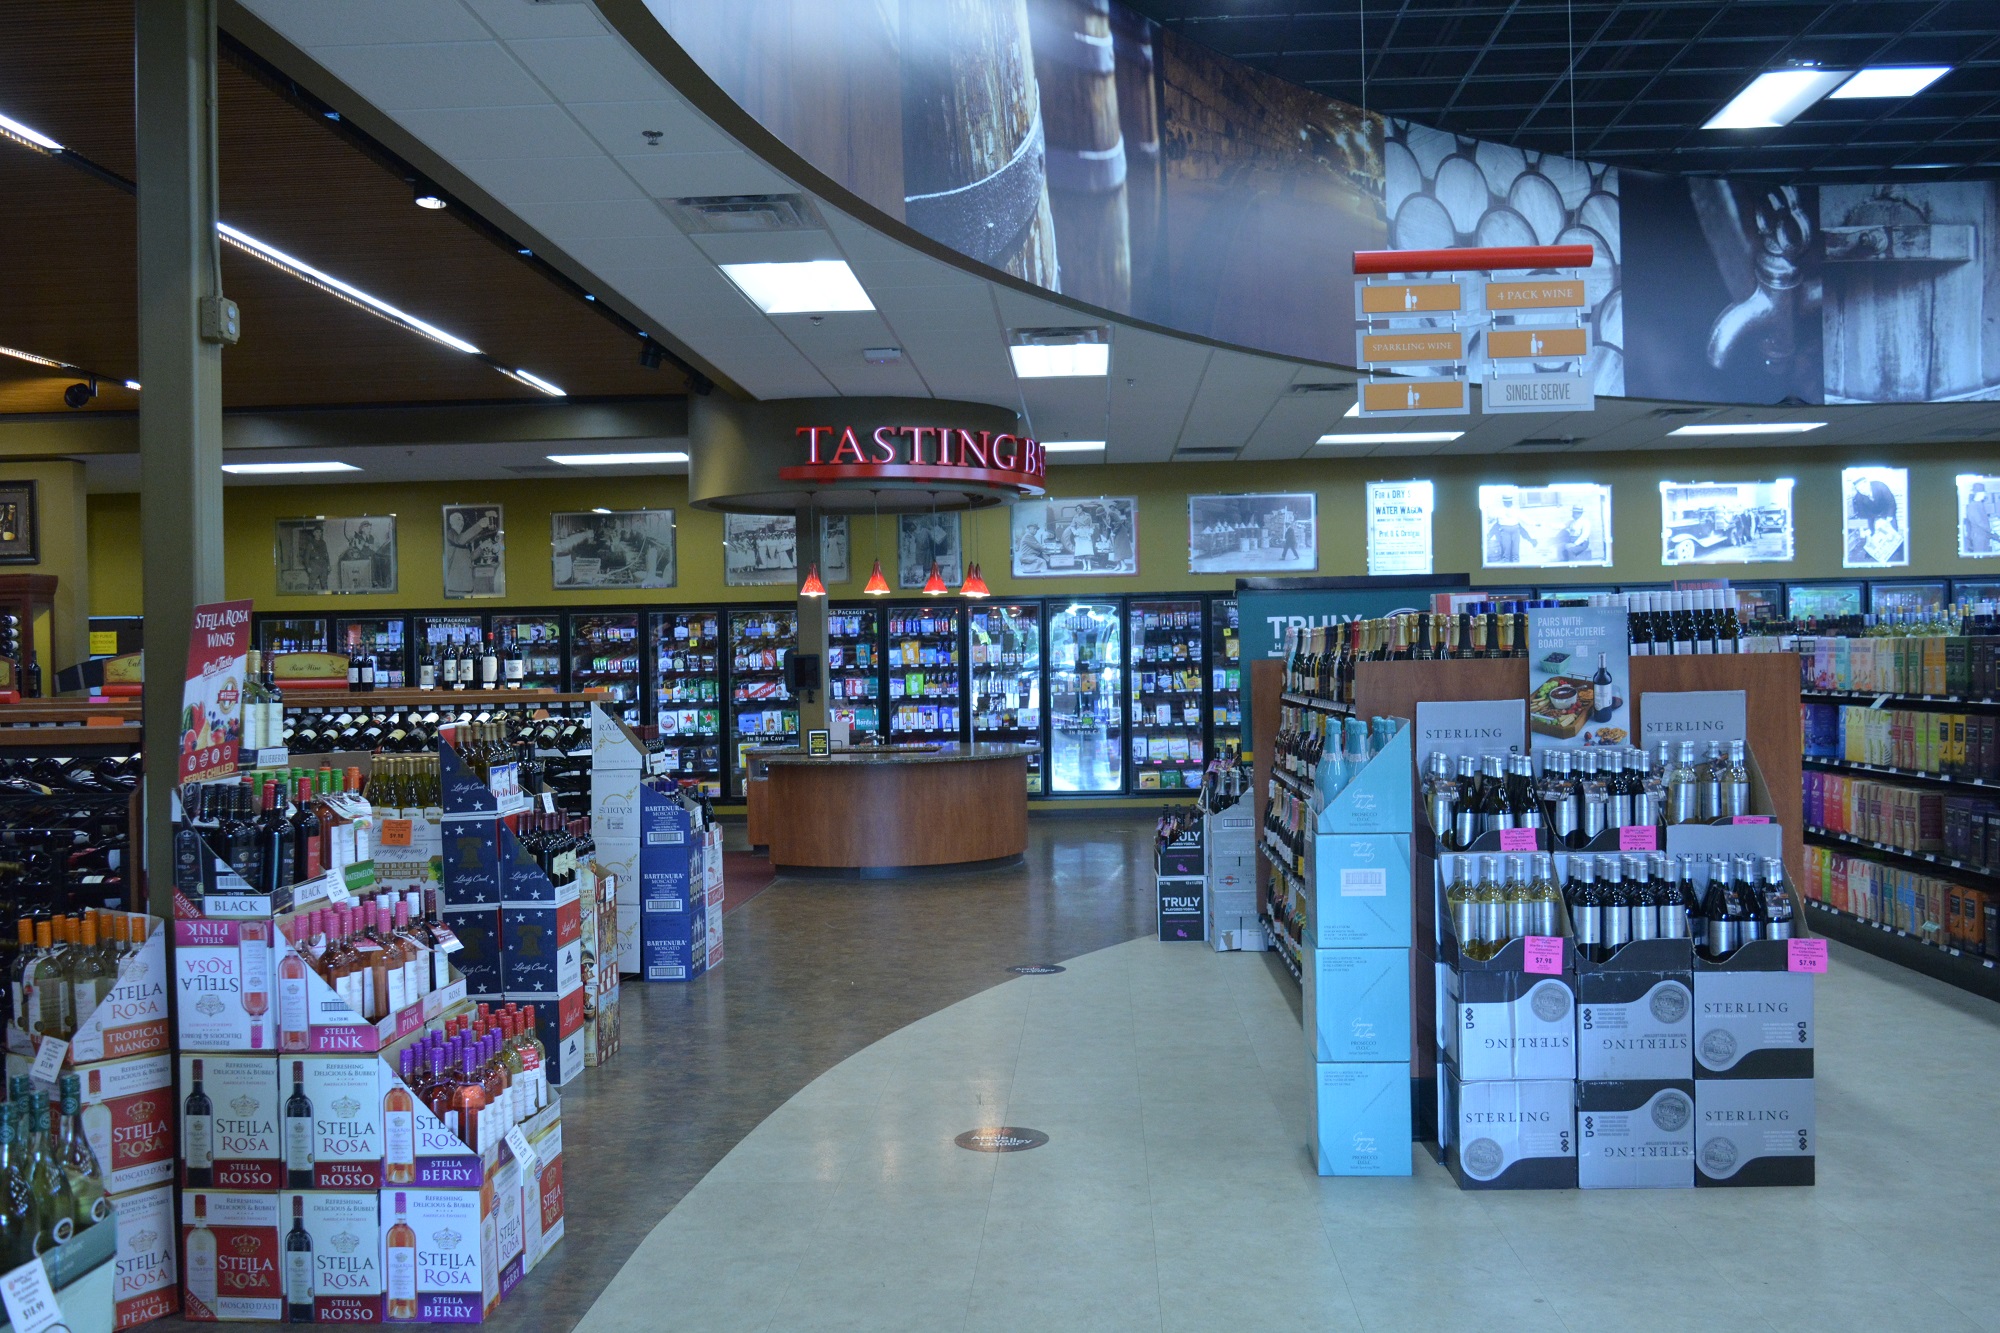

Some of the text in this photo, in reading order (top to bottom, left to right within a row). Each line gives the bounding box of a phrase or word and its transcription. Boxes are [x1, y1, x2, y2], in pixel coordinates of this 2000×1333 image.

[1497, 288, 1573, 301] 4 PACK WINE
[1372, 341, 1452, 352] SPARKLING WINE
[1505, 383, 1571, 402] SINGLE SERVE
[795, 425, 1017, 471] TASTING
[1376, 506, 1423, 515] WATER WAGON
[195, 609, 249, 631] STELLA ROSA
[1538, 616, 1583, 626] PAIRS WITH:
[1538, 627, 1605, 637] A SNACK-CUTERIE
[207, 632, 235, 648] WINES
[1538, 639, 1563, 648] BOARD
[599, 723, 619, 731] RAD
[1647, 721, 1724, 732] STERLING
[1426, 729, 1502, 740] STERLING
[259, 754, 288, 764] BLUEBERRY
[183, 762, 235, 785] SERVE CHILLED
[451, 782, 470, 792] Liberty
[1675, 852, 1757, 863] STERLING
[345, 867, 375, 881] WATERMELON
[454, 874, 472, 885] Liberty
[509, 871, 544, 881] Liberty Creek
[301, 885, 321, 900] BLACK
[175, 893, 202, 919] LUXURY
[214, 899, 258, 911] BLACK
[1162, 896, 1201, 907] TRULY
[188, 923, 229, 936] PINK
[185, 957, 232, 975] ROSA
[511, 962, 548, 972] Liberty Creek
[181, 975, 238, 992] STELLA
[106, 982, 163, 1003] STELLA
[112, 1000, 159, 1020] ROSA
[1704, 1002, 1788, 1013] STERLING
[402, 1015, 419, 1033] PINK
[107, 1025, 165, 1043] TROPICAL
[114, 1037, 160, 1054] MANGO
[320, 1036, 363, 1049] PINK
[1485, 1037, 1569, 1048] STERLING
[1602, 1038, 1687, 1050] STERLING
[121, 1062, 158, 1074] REFRESHING
[416, 1115, 447, 1130] STE
[1466, 1112, 1550, 1123] STERLING
[1706, 1110, 1790, 1121] STERLING
[113, 1120, 168, 1143] STELLA
[216, 1119, 274, 1137] STELLA
[317, 1120, 375, 1138] STELLA
[119, 1138, 164, 1158] ROSA
[222, 1136, 269, 1153] ROSA
[323, 1138, 371, 1155] ROSA
[1603, 1146, 1689, 1158] STERLING
[115, 1169, 149, 1183] MOSCATO
[331, 1165, 363, 1173] STELLA
[422, 1169, 472, 1181] BERRY
[220, 1172, 273, 1184] ROSSO
[321, 1174, 375, 1186] ROSSO
[543, 1188, 561, 1211] STELLA
[499, 1215, 521, 1244] STELLA
[501, 1239, 520, 1261] ROSA
[116, 1249, 171, 1276] STELLA
[218, 1255, 274, 1273] STELLA
[317, 1255, 374, 1272] STELLA
[418, 1251, 476, 1270] STELLA
[122, 1269, 168, 1291] ROSA
[223, 1271, 270, 1289] ROSA
[323, 1272, 370, 1289] ROSA
[424, 1269, 471, 1286] ROSA
[503, 1267, 520, 1292] BERRY
[131, 1296, 161, 1310] STELLA
[186, 1292, 210, 1318] LUXURY
[220, 1301, 278, 1310] MOSCATO D'ASTI
[331, 1299, 362, 1307] STELLA
[432, 1296, 463, 1304] STELLA
[22, 1300, 45, 1320] $18.99
[122, 1301, 170, 1326] PEACH
[321, 1308, 373, 1320] ROSSO
[423, 1306, 474, 1318] BERRY
